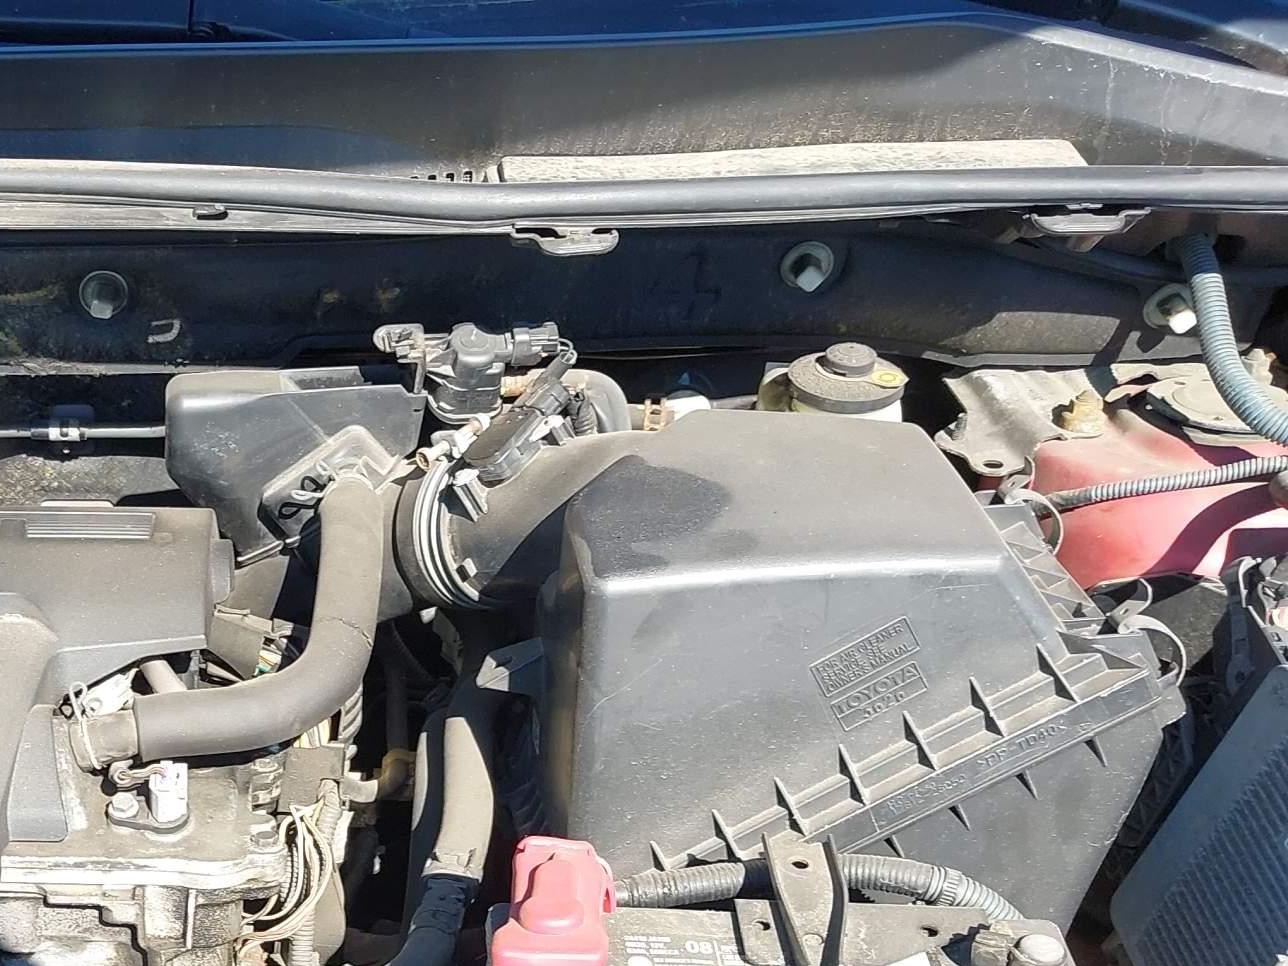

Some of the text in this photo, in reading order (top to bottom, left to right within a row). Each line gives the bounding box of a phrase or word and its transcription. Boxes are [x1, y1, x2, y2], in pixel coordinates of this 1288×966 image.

[816, 623, 905, 676] FOR AIR CLEANER
[867, 645, 887, 660] SEE
[869, 642, 915, 670] MANUAL
[836, 664, 920, 715] TOYOTA
[685, 940, 713, 955] 08
